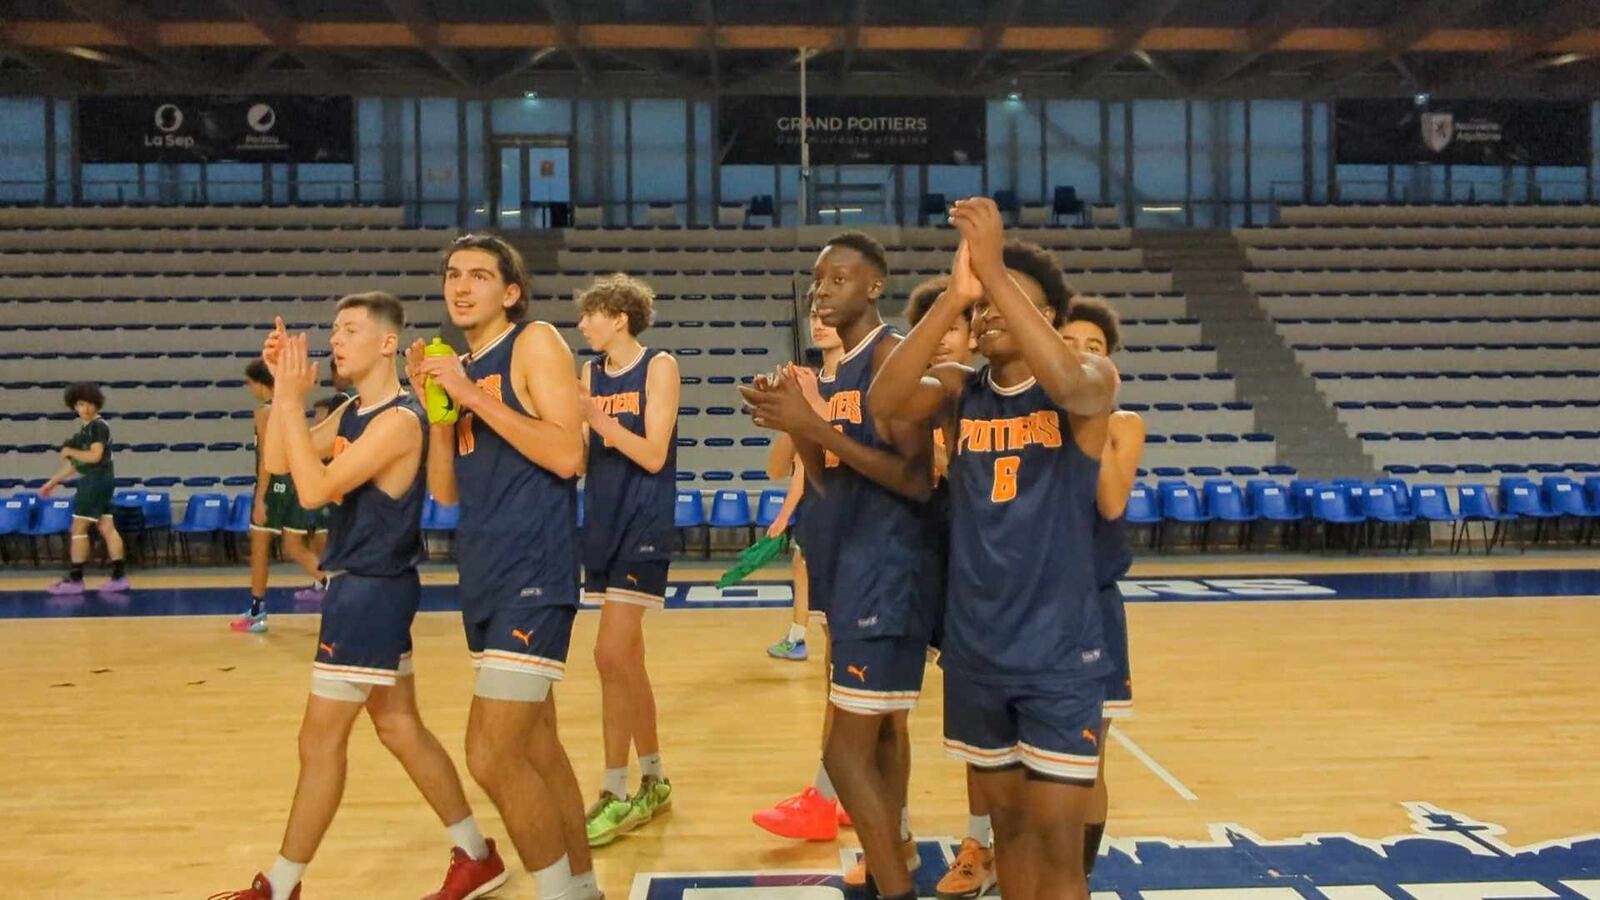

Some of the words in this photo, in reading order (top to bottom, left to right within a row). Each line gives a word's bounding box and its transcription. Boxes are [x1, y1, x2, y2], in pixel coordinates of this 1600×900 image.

[776, 117, 843, 131] GRAND
[847, 117, 928, 131] POITIERS
[144, 135, 163, 146] La
[165, 135, 194, 148] Sep
[957, 410, 1063, 456] POITIERS
[991, 455, 1021, 503] 6
